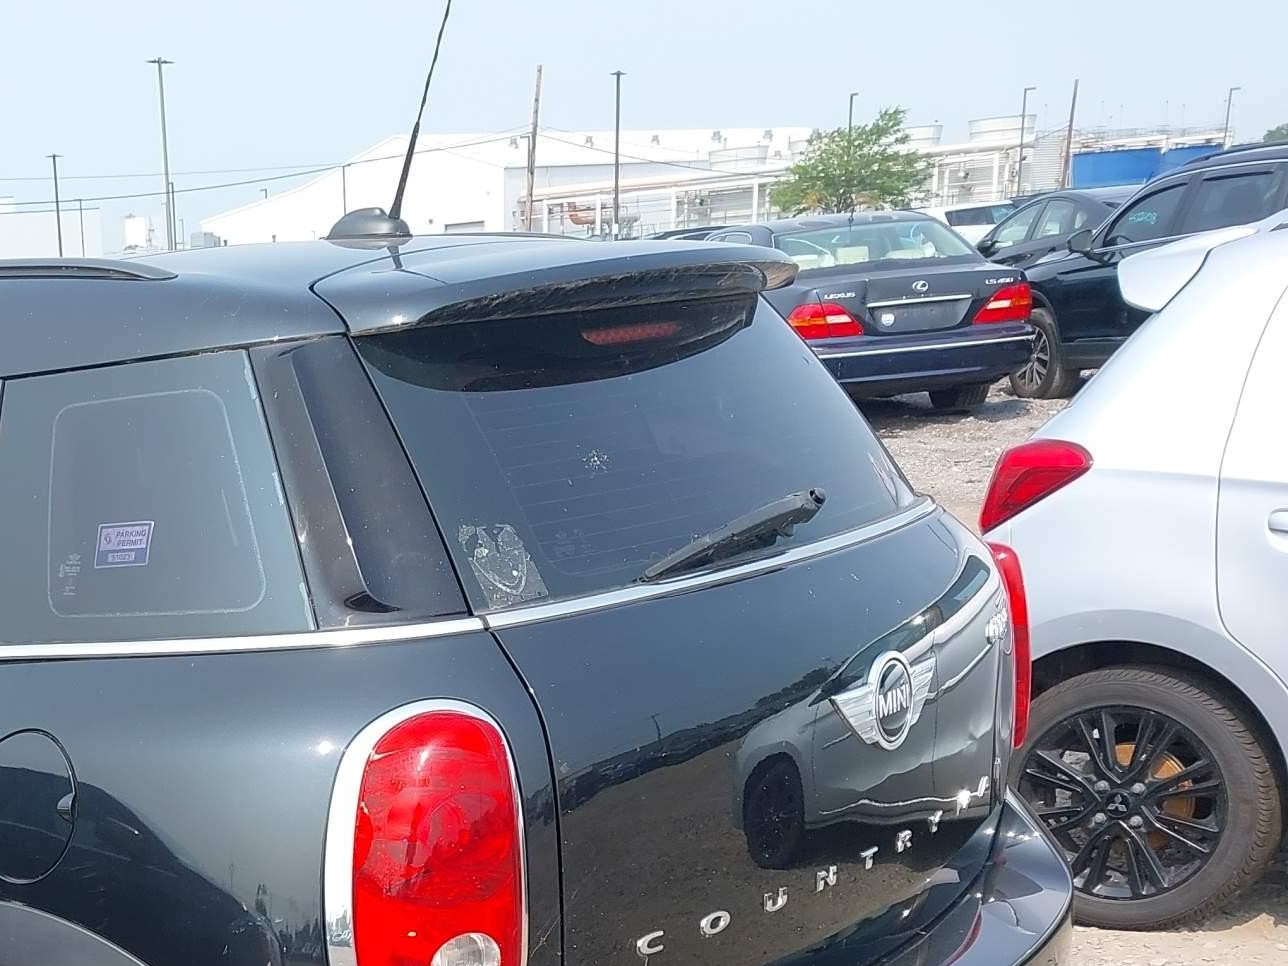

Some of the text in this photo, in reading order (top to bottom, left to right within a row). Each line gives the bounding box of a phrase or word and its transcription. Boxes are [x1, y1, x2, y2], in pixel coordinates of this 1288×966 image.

[116, 529, 146, 539] PARKING
[117, 538, 144, 547] PERMIT
[878, 680, 911, 721] MINI
